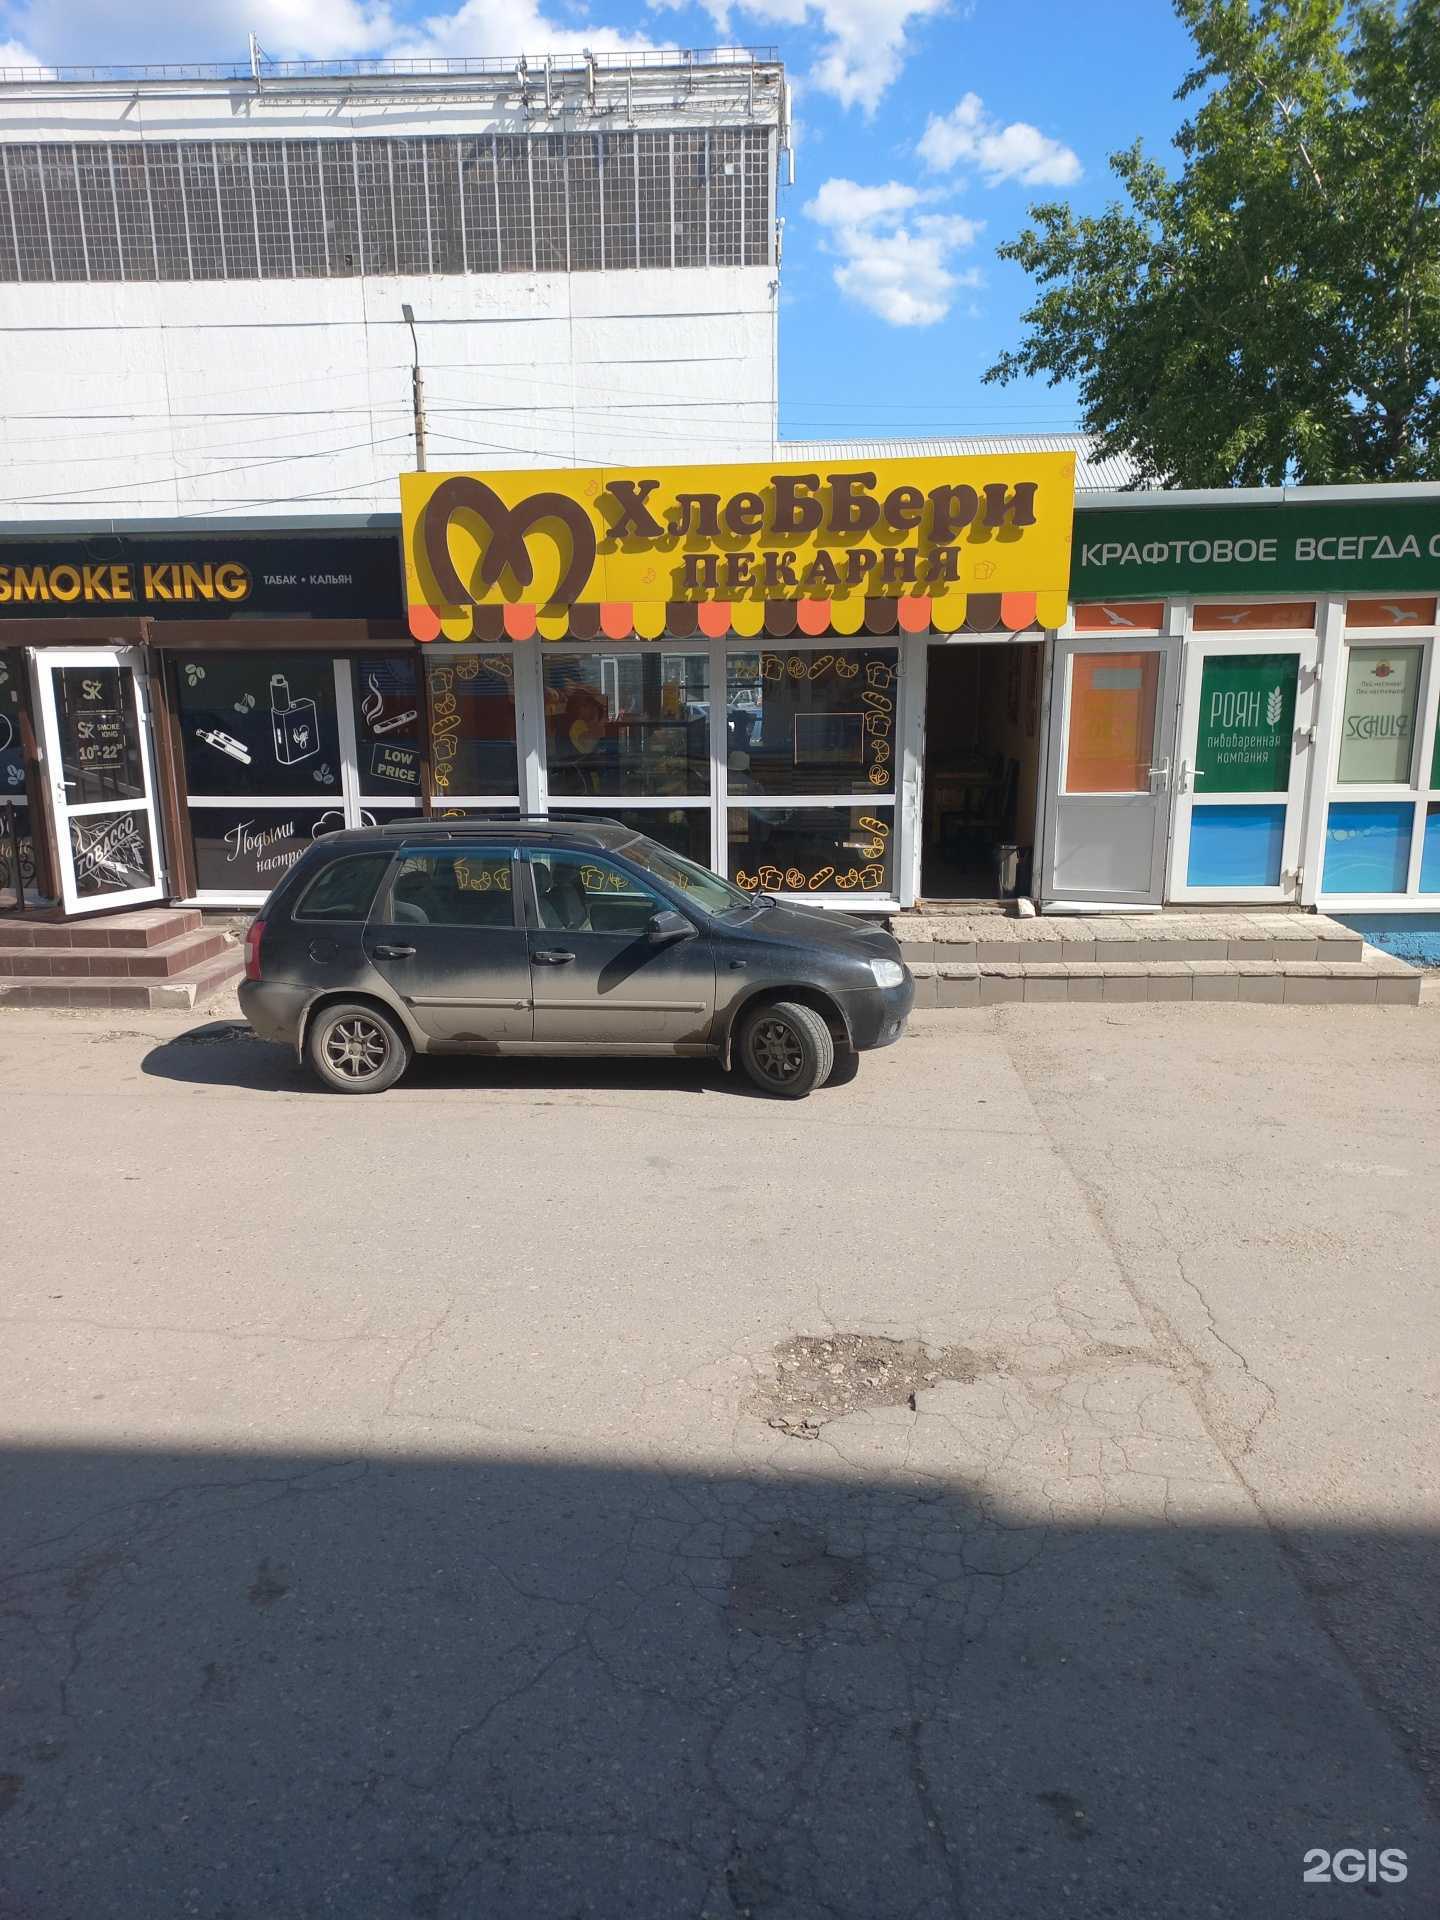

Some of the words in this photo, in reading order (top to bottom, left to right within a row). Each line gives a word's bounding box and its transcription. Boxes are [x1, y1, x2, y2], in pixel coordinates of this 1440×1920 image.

[605, 471, 1039, 544] ХлеББери
[682, 545, 963, 589] ПЕКАРНЯ
[1081, 538, 1278, 567] КРАФТОВОЕ
[1295, 533, 1422, 561] ВСЕГДА
[0, 564, 133, 602] SMOKE
[144, 561, 248, 601] KING
[263, 574, 298, 586] ТАБАК
[309, 574, 353, 586] КАЛЬЯН
[1210, 691, 1261, 728] РОЯН
[383, 748, 414, 765] LOW
[1207, 732, 1281, 751] пивоваренная
[1217, 751, 1270, 765] компания
[376, 763, 417, 782] PRICE
[77, 816, 134, 875] TOBACCO
[224, 819, 295, 862] Подыми
